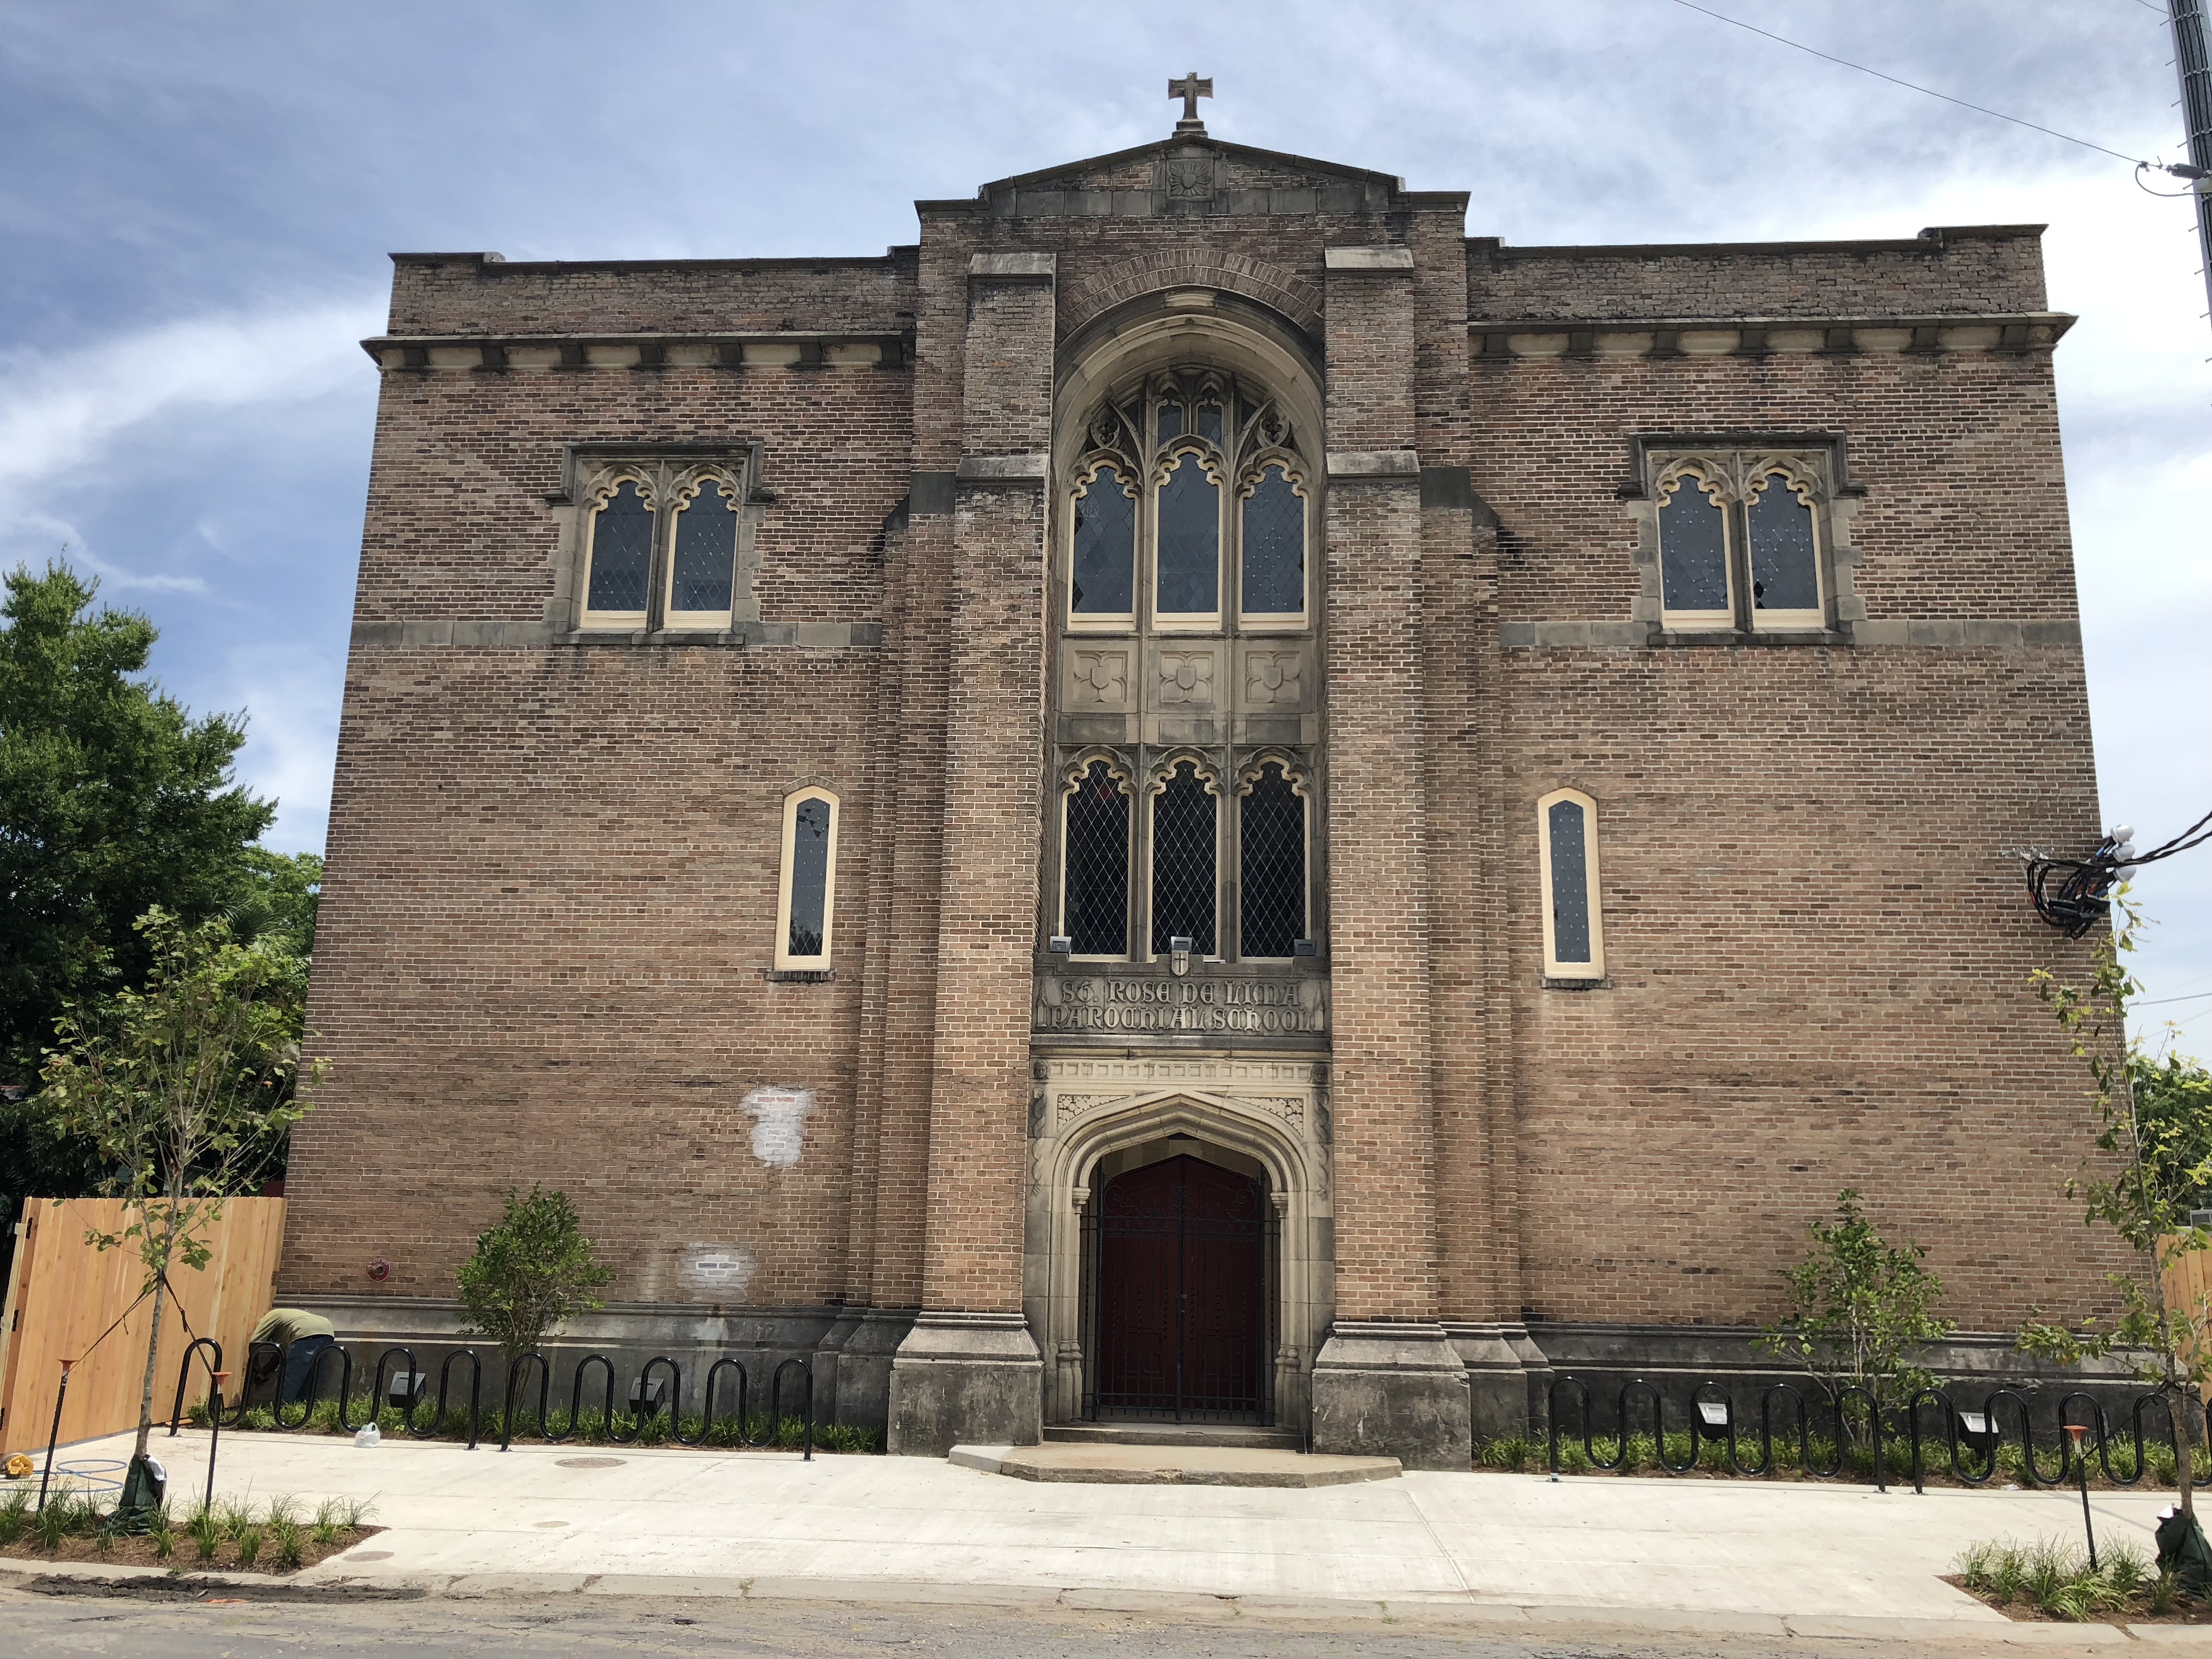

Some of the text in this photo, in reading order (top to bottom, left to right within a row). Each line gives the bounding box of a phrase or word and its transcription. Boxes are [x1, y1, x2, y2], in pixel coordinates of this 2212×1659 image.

[1107, 979, 1172, 1003] ROSE
[1181, 981, 1216, 1005] DE
[1224, 980, 1300, 1006] LIMA
[1049, 1005, 1312, 1031] PAROCHIAL SCHOOL
